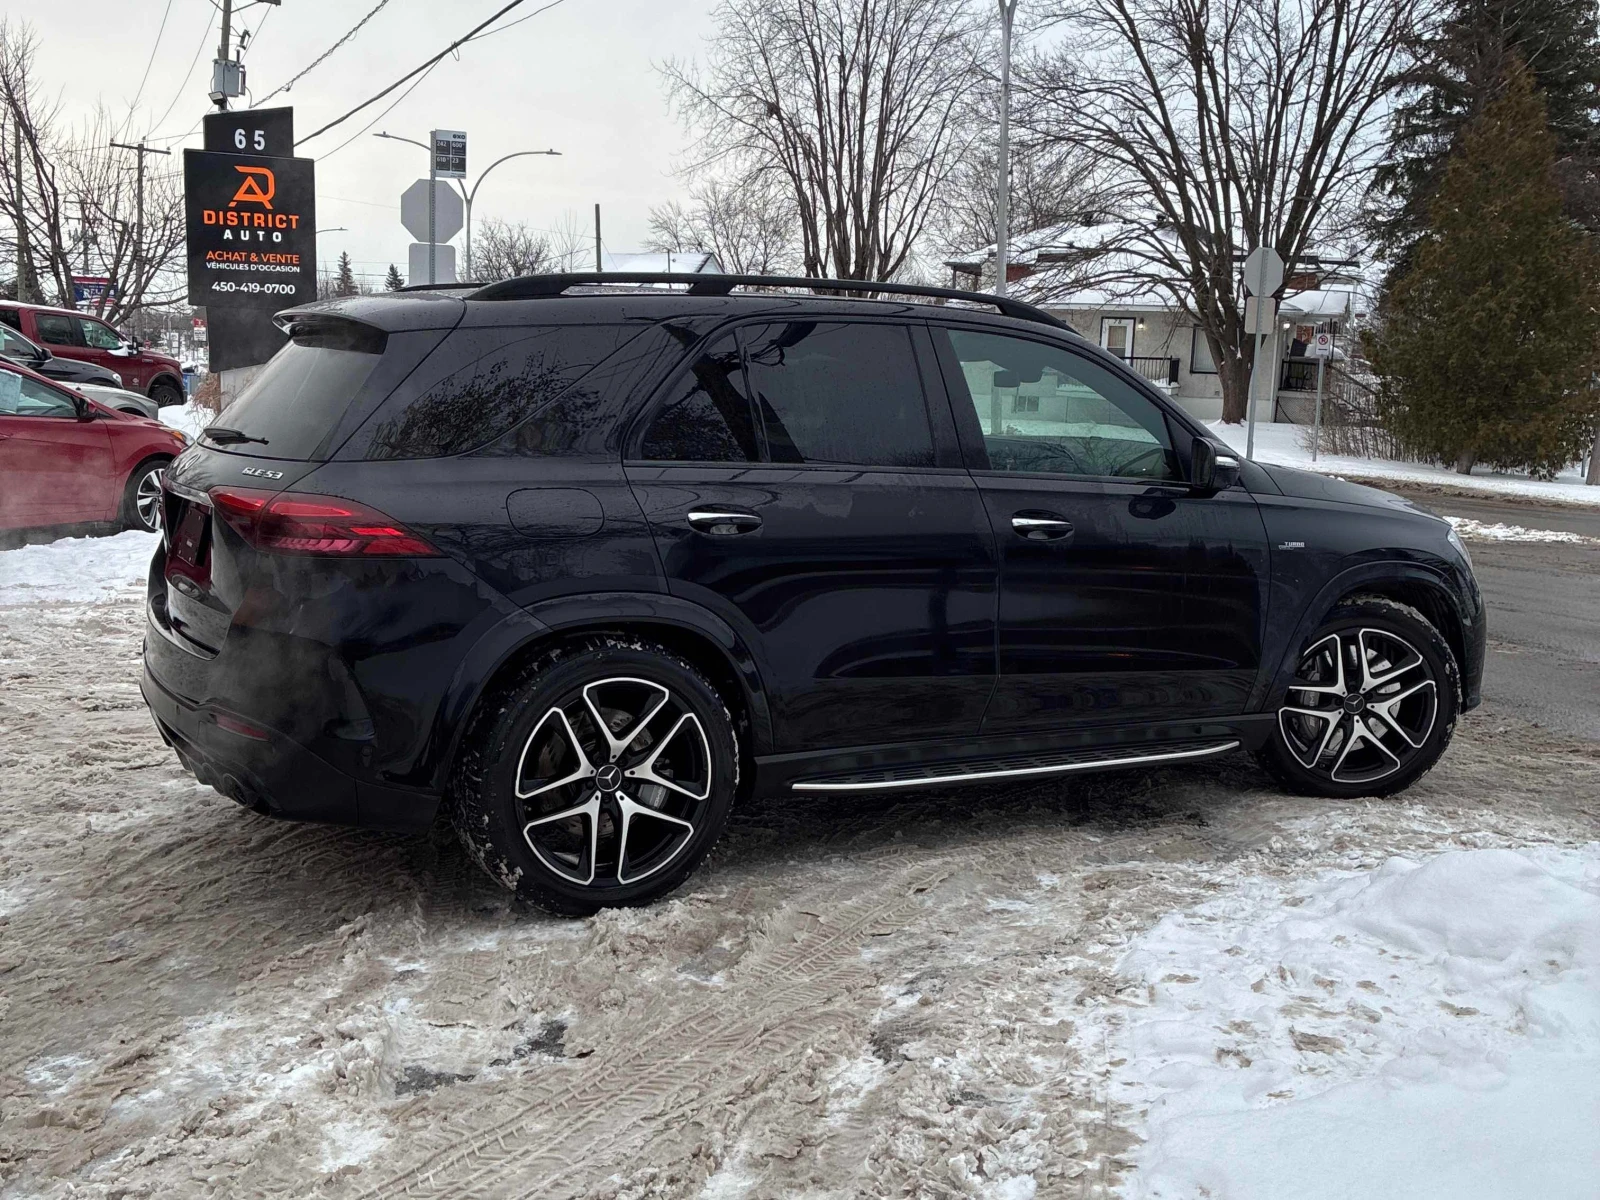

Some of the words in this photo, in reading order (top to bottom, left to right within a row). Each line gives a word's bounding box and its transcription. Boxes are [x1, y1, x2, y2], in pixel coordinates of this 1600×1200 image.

[234, 128, 265, 150] 65
[203, 210, 300, 229] DISTRICT
[223, 229, 282, 243] AUTO
[206, 250, 248, 261] ACHAT
[249, 252, 259, 262] &
[261, 253, 300, 264] VENTE
[206, 261, 249, 270] VÉHICULES
[250, 264, 300, 273] D'OCCASION
[211, 281, 296, 295] 450-419-0700
